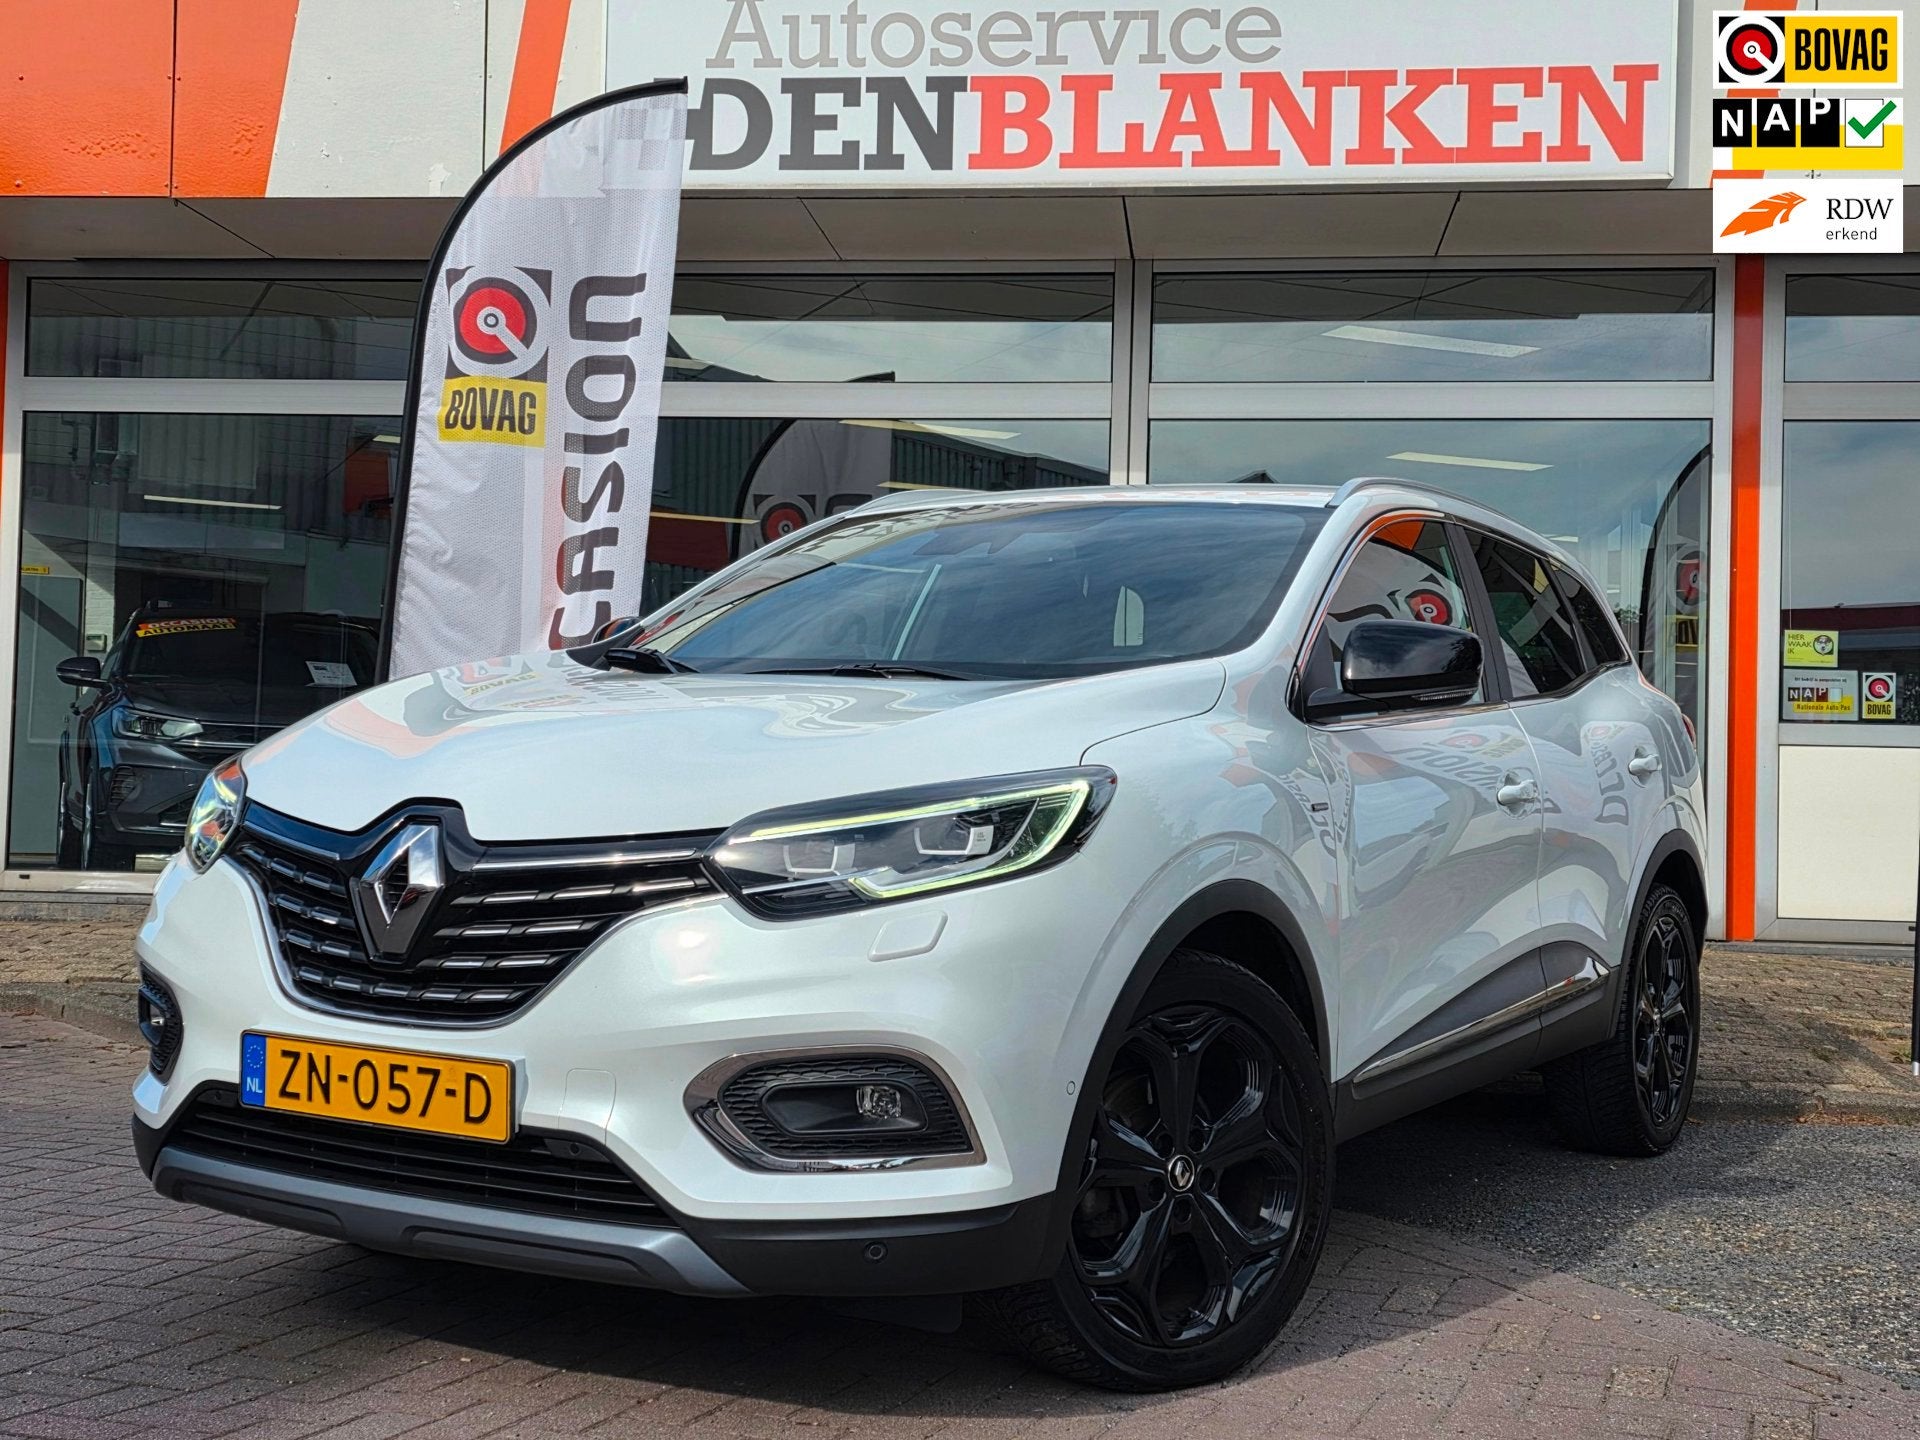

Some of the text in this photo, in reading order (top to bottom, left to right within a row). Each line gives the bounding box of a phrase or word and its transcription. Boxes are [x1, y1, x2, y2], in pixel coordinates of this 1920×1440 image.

[705, 0, 1283, 69] Autoservice
[444, 387, 538, 435] BOVAG
[144, 623, 233, 635] AUTOMAAT
[1788, 633, 1805, 641] HIER
[1867, 704, 1891, 715] BOVAG
[246, 1077, 263, 1094] NL
[278, 1049, 492, 1125] ZN-057-D
